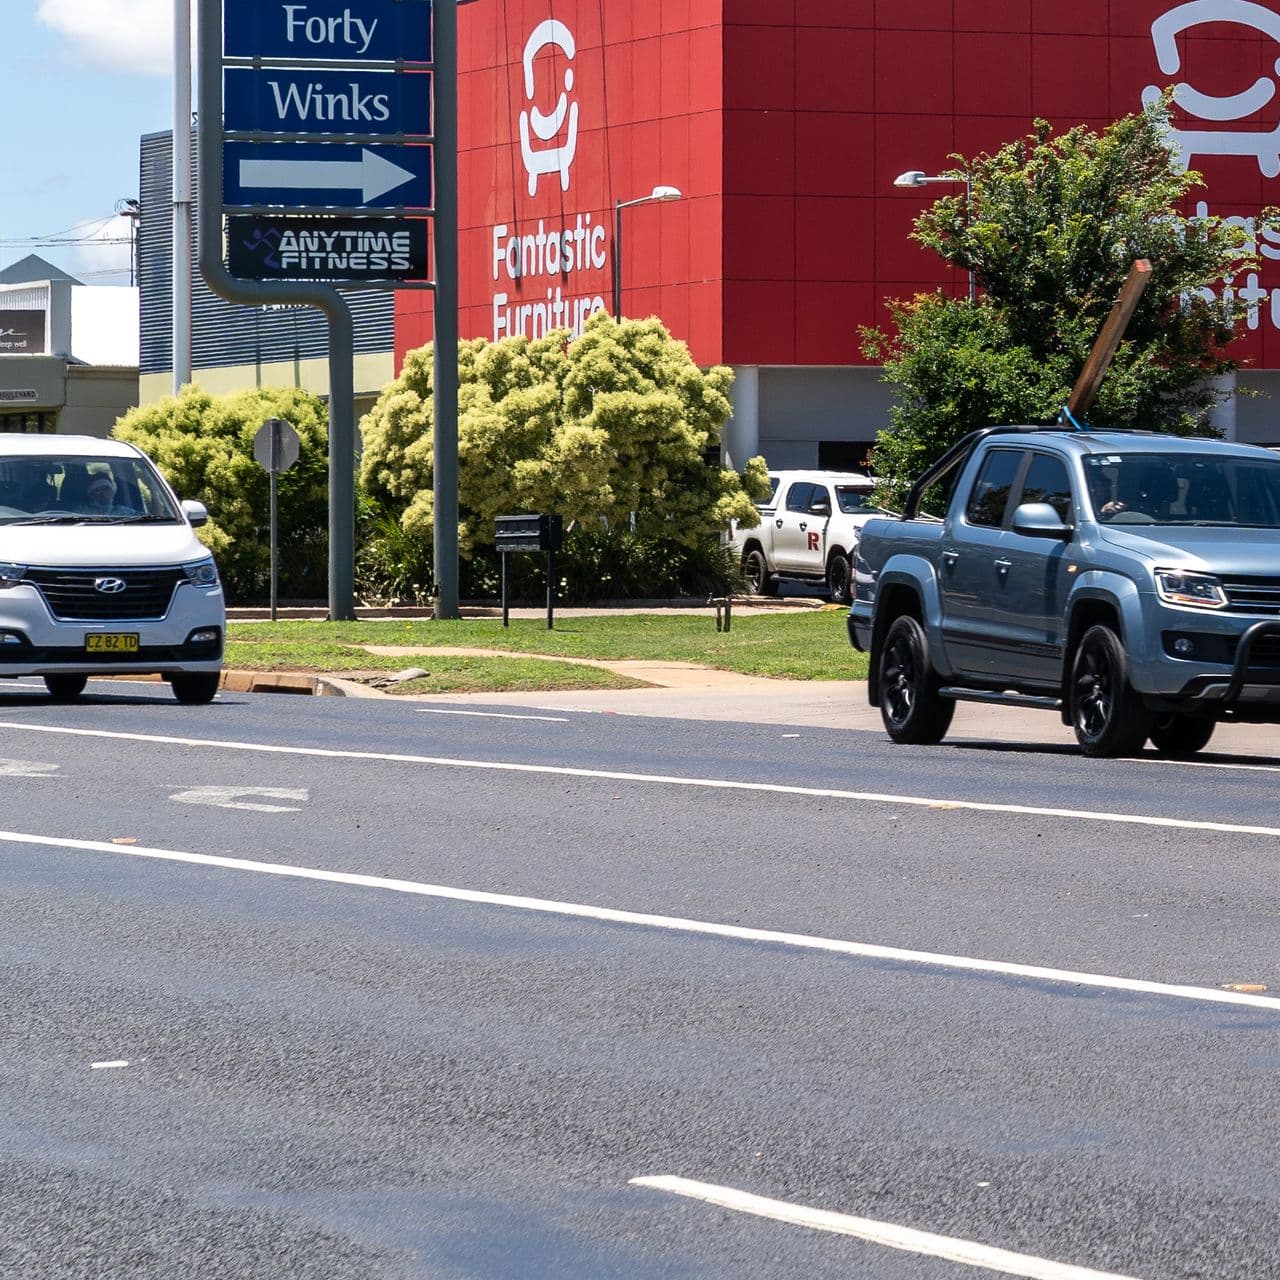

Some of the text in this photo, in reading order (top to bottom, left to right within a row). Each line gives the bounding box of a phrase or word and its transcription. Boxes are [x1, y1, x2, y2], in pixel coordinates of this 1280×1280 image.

[282, 4, 378, 54] Forty
[267, 80, 390, 122] Winks
[278, 230, 410, 252] ANYTIME
[493, 212, 606, 280] Fantastic
[280, 252, 410, 270] FITNESS
[807, 531, 820, 551] R
